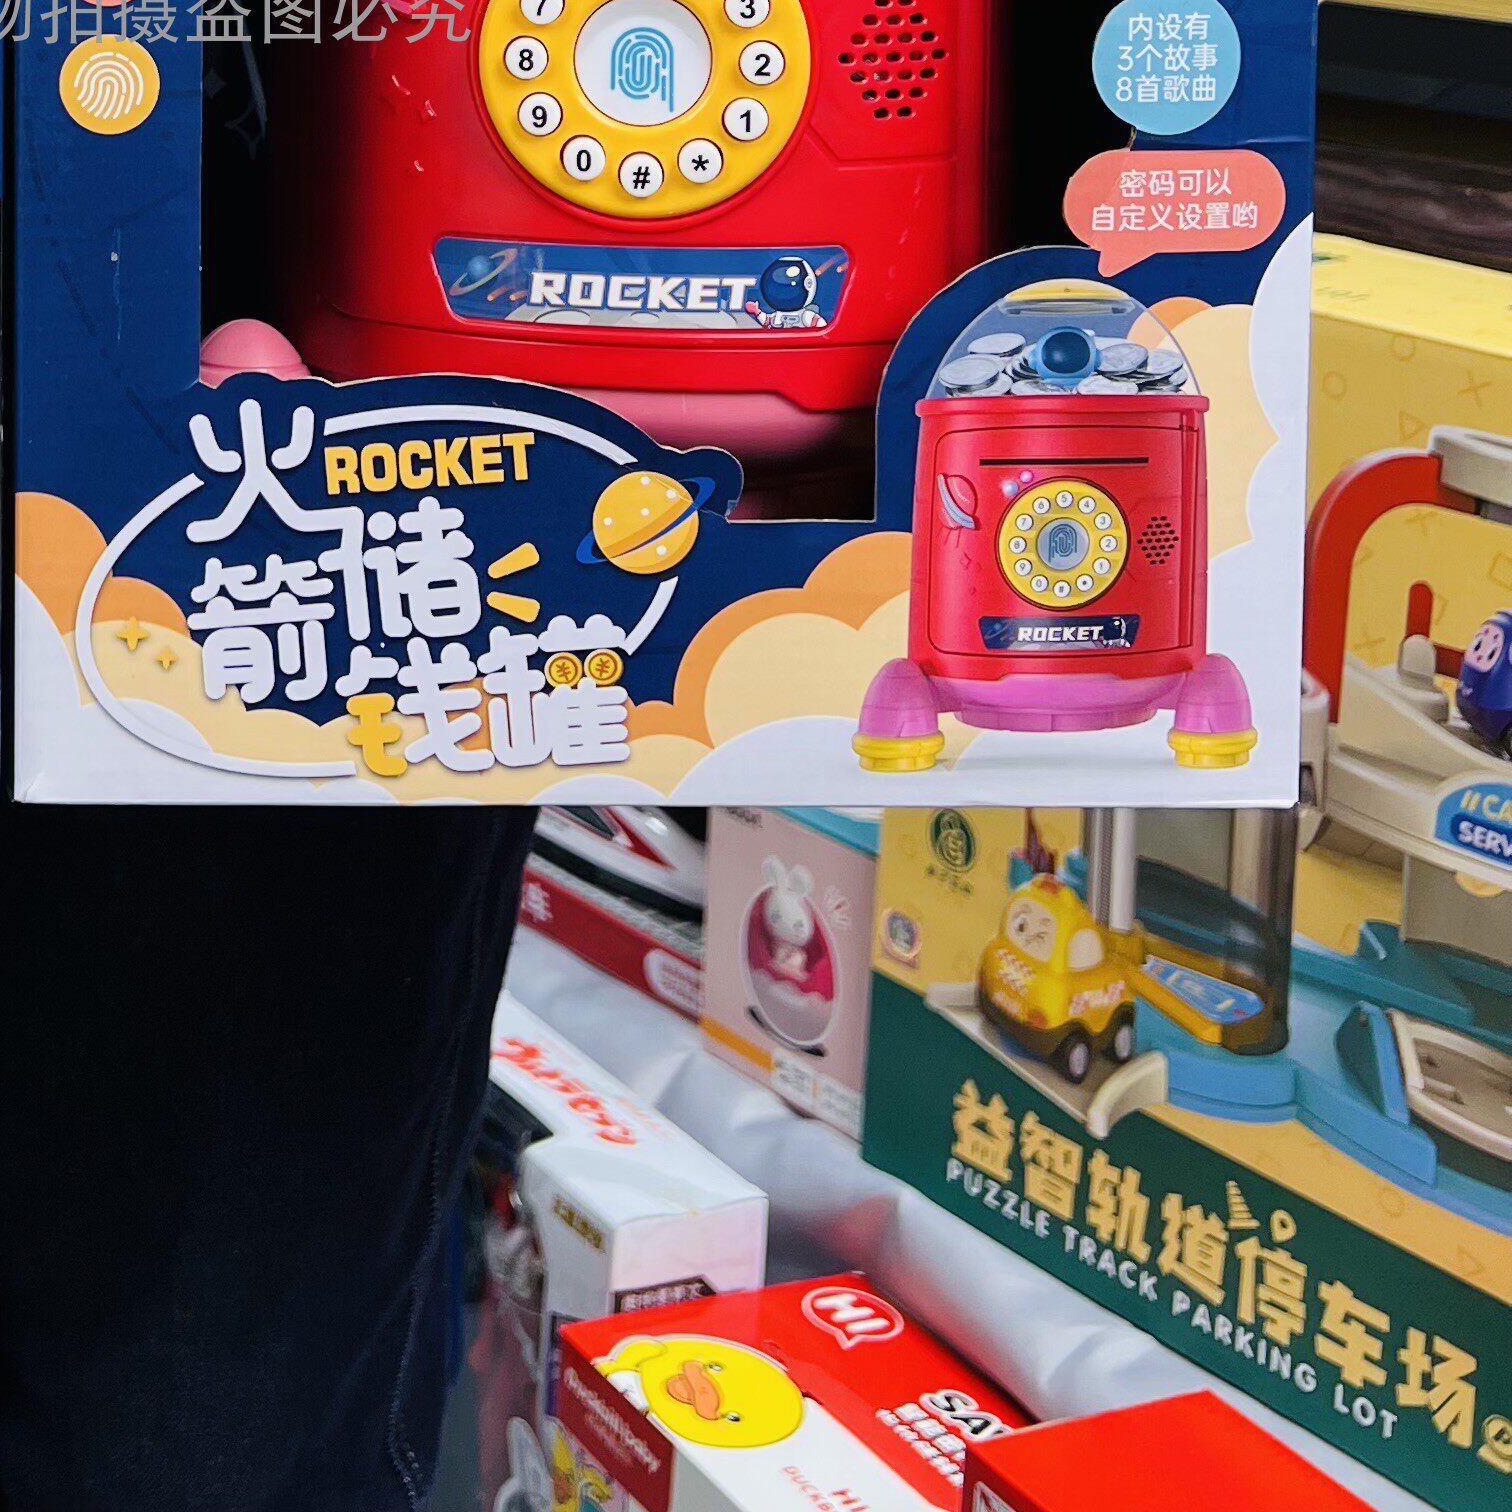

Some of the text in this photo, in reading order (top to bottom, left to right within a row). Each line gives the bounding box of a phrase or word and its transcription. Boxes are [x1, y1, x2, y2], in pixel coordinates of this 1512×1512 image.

[1127, 12, 1211, 42] 内设有
[518, 48, 534, 72] 8
[754, 53, 771, 77] 2
[1117, 44, 1218, 72] 3个故事
[1115, 74, 1217, 103] 8首歌曲
[531, 105, 548, 129] 9
[739, 109, 752, 133] 1
[576, 149, 592, 172] 0
[632, 166, 651, 190] #
[1119, 168, 1233, 199] 密码可以
[1091, 201, 1258, 232] 自定义设置哟
[529, 271, 757, 311] ROCKET
[324, 432, 535, 495] ROCKET
[1017, 626, 1104, 642] ROCKET
[951, 1078, 1480, 1450] 益智轨道停车场
[945, 1158, 1400, 1440] PUZZLE TRACK PARKING LOT
